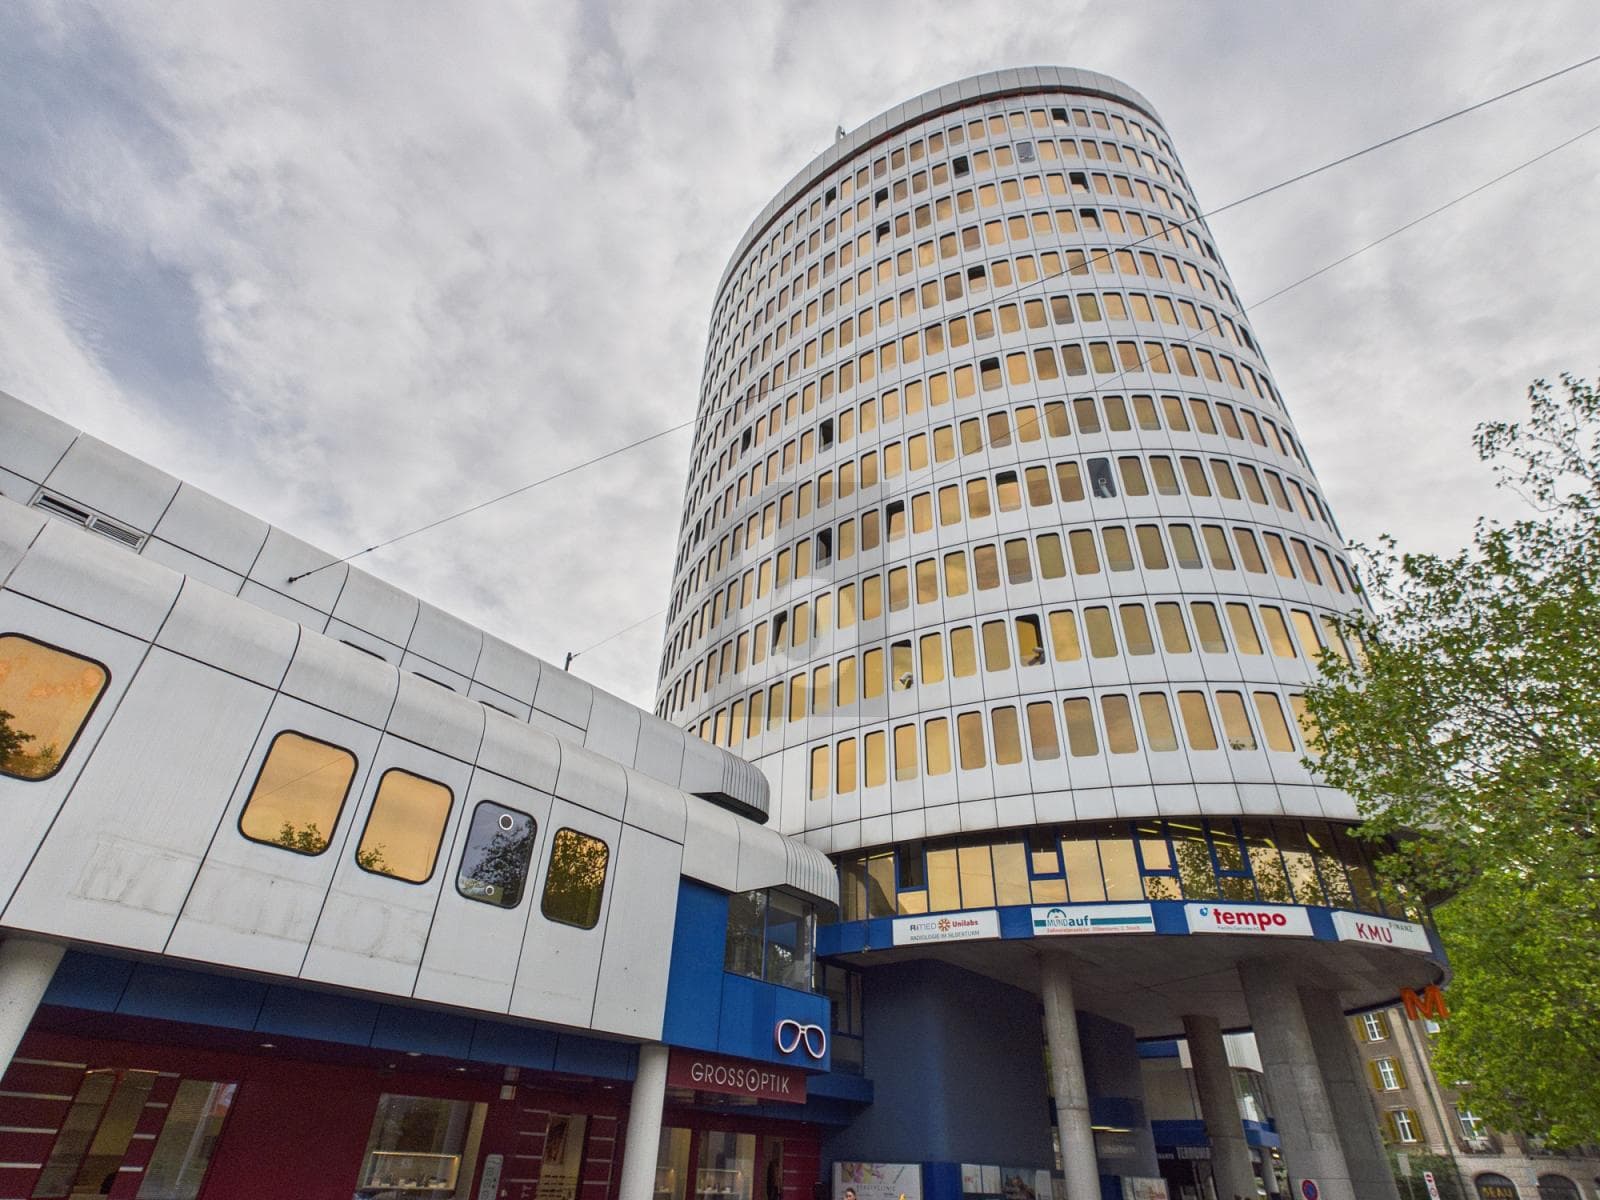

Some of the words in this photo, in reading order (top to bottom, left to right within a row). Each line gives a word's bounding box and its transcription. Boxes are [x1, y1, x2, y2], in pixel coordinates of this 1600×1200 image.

[952, 919, 979, 928] Unilabs
[1213, 908, 1287, 931] tempo
[1355, 922, 1393, 943] KMU
[1400, 985, 1450, 1020] M
[691, 1062, 790, 1094] GROSSOPTIK
